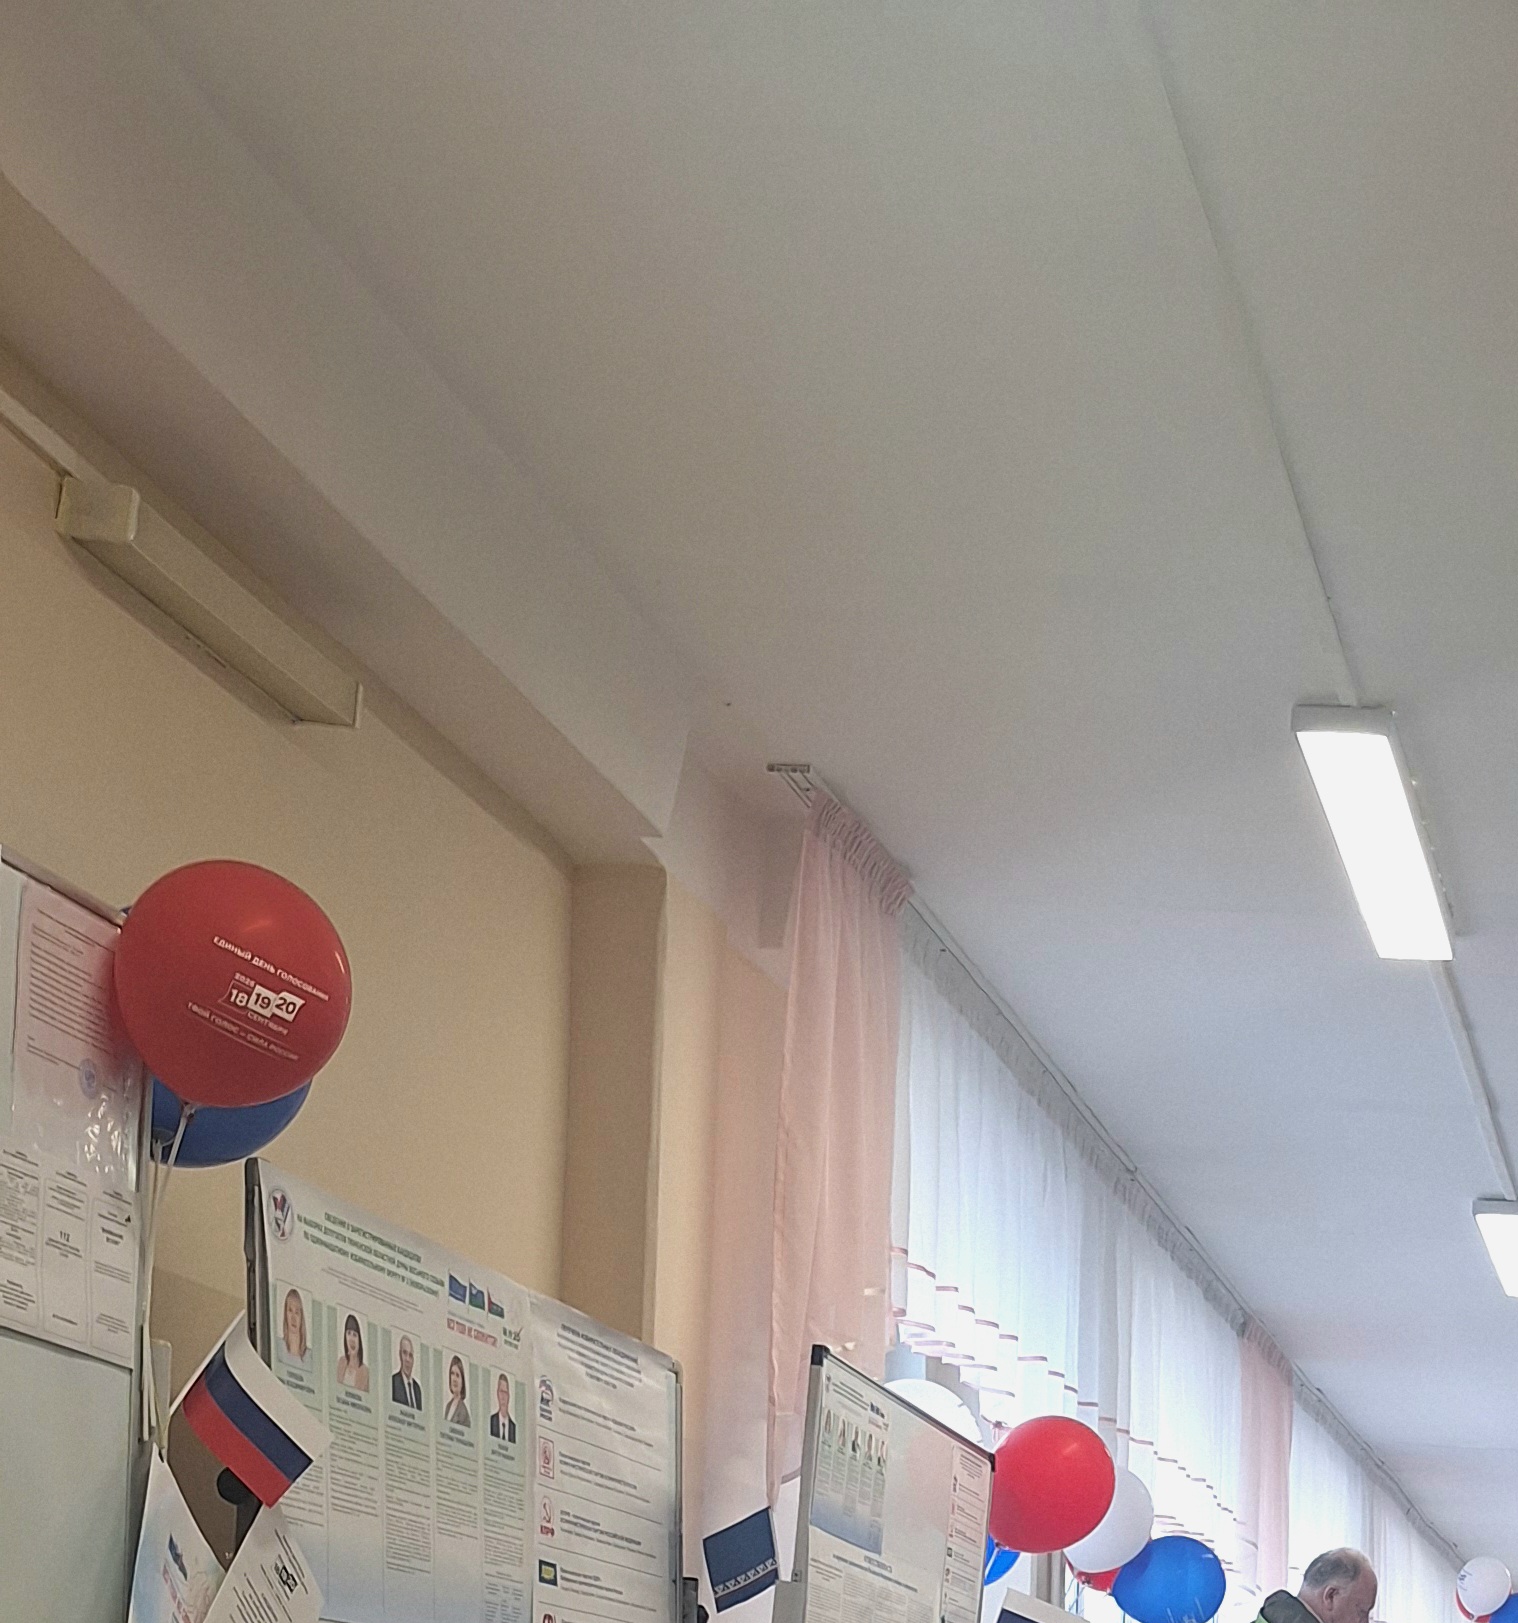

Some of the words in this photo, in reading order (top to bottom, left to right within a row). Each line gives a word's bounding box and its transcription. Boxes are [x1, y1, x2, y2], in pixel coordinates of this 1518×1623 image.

[252, 957, 275, 974] ДЕНЬ
[229, 988, 249, 1007] 18
[254, 992, 272, 1010] 19
[274, 996, 297, 1015] 20
